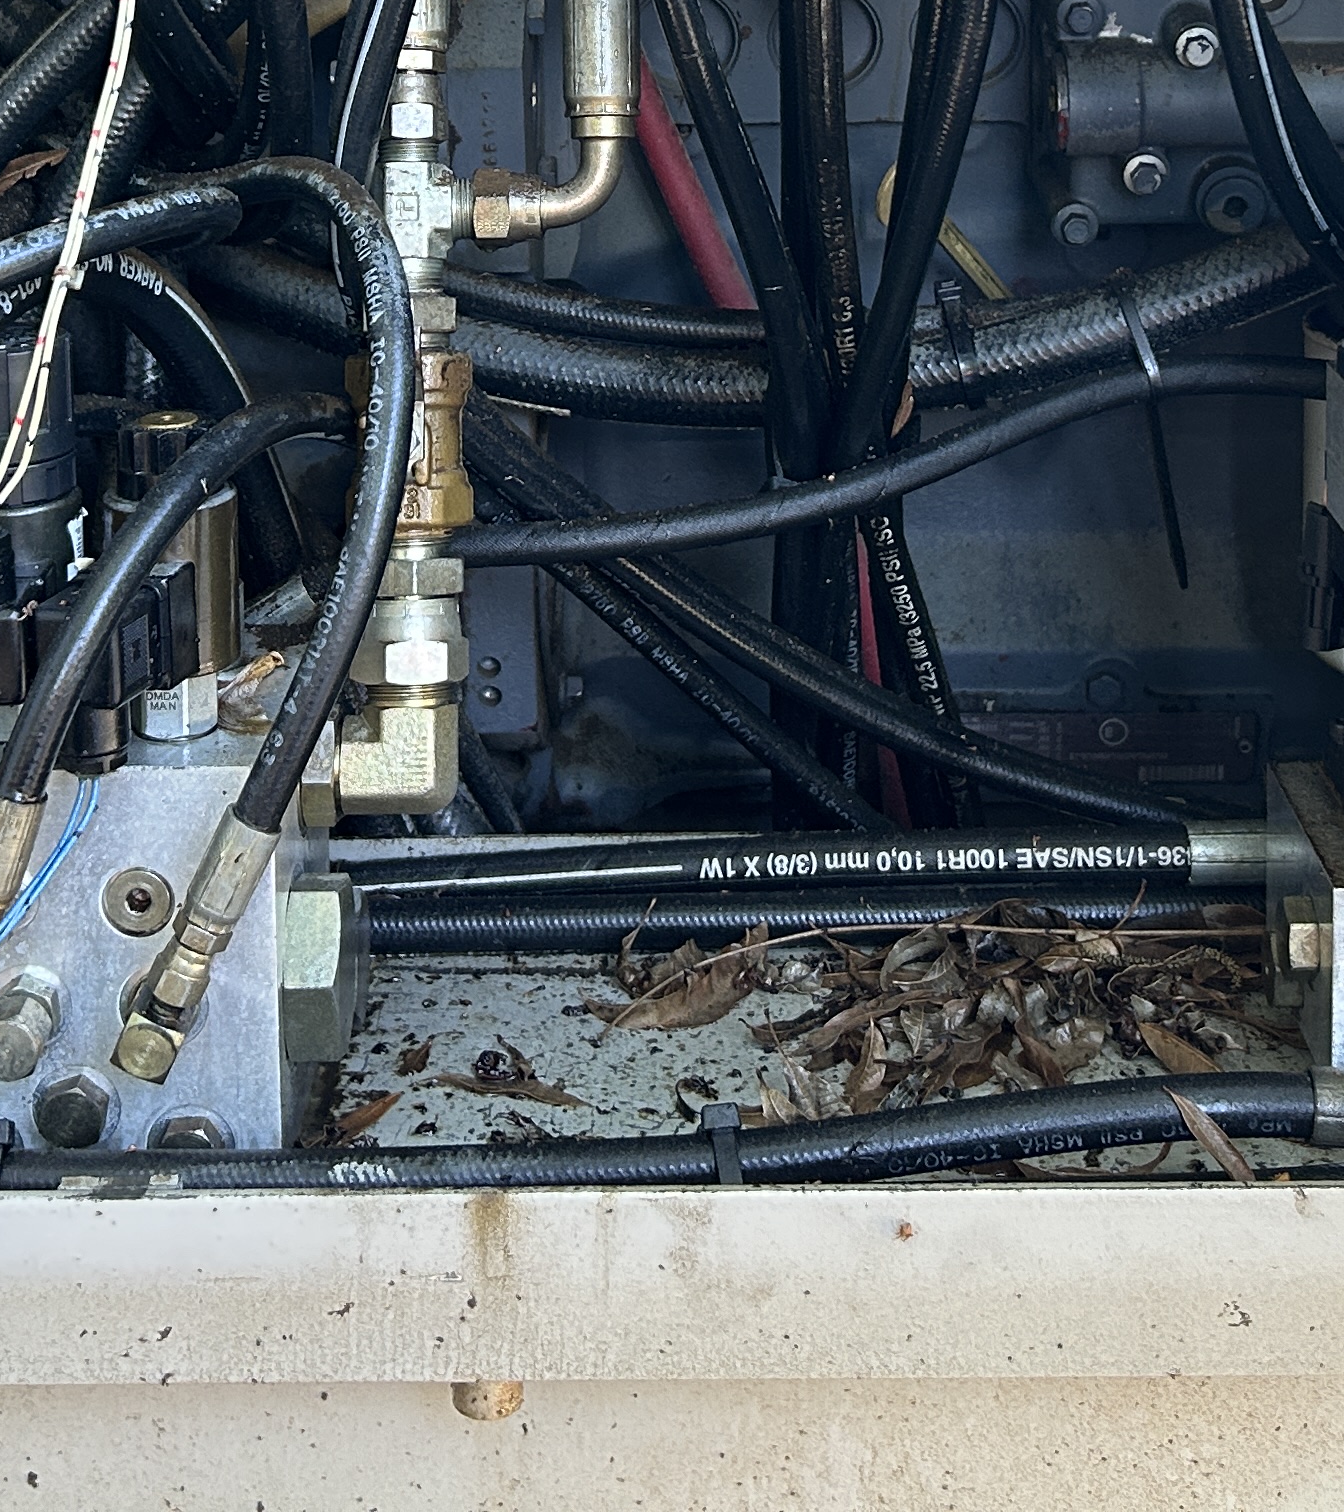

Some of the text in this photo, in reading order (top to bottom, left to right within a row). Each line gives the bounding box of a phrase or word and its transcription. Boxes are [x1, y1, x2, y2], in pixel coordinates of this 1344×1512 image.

[119, 252, 164, 296] PARKER
[361, 266, 388, 324] MSHA
[890, 584, 921, 626] (3250
[906, 626, 930, 660] MPa
[150, 702, 177, 711] MAN
[743, 854, 761, 878] X
[766, 852, 818, 877] (3/8)
[823, 852, 871, 871] mm
[876, 849, 925, 873] 10,0
[936, 848, 1008, 871] 100R1
